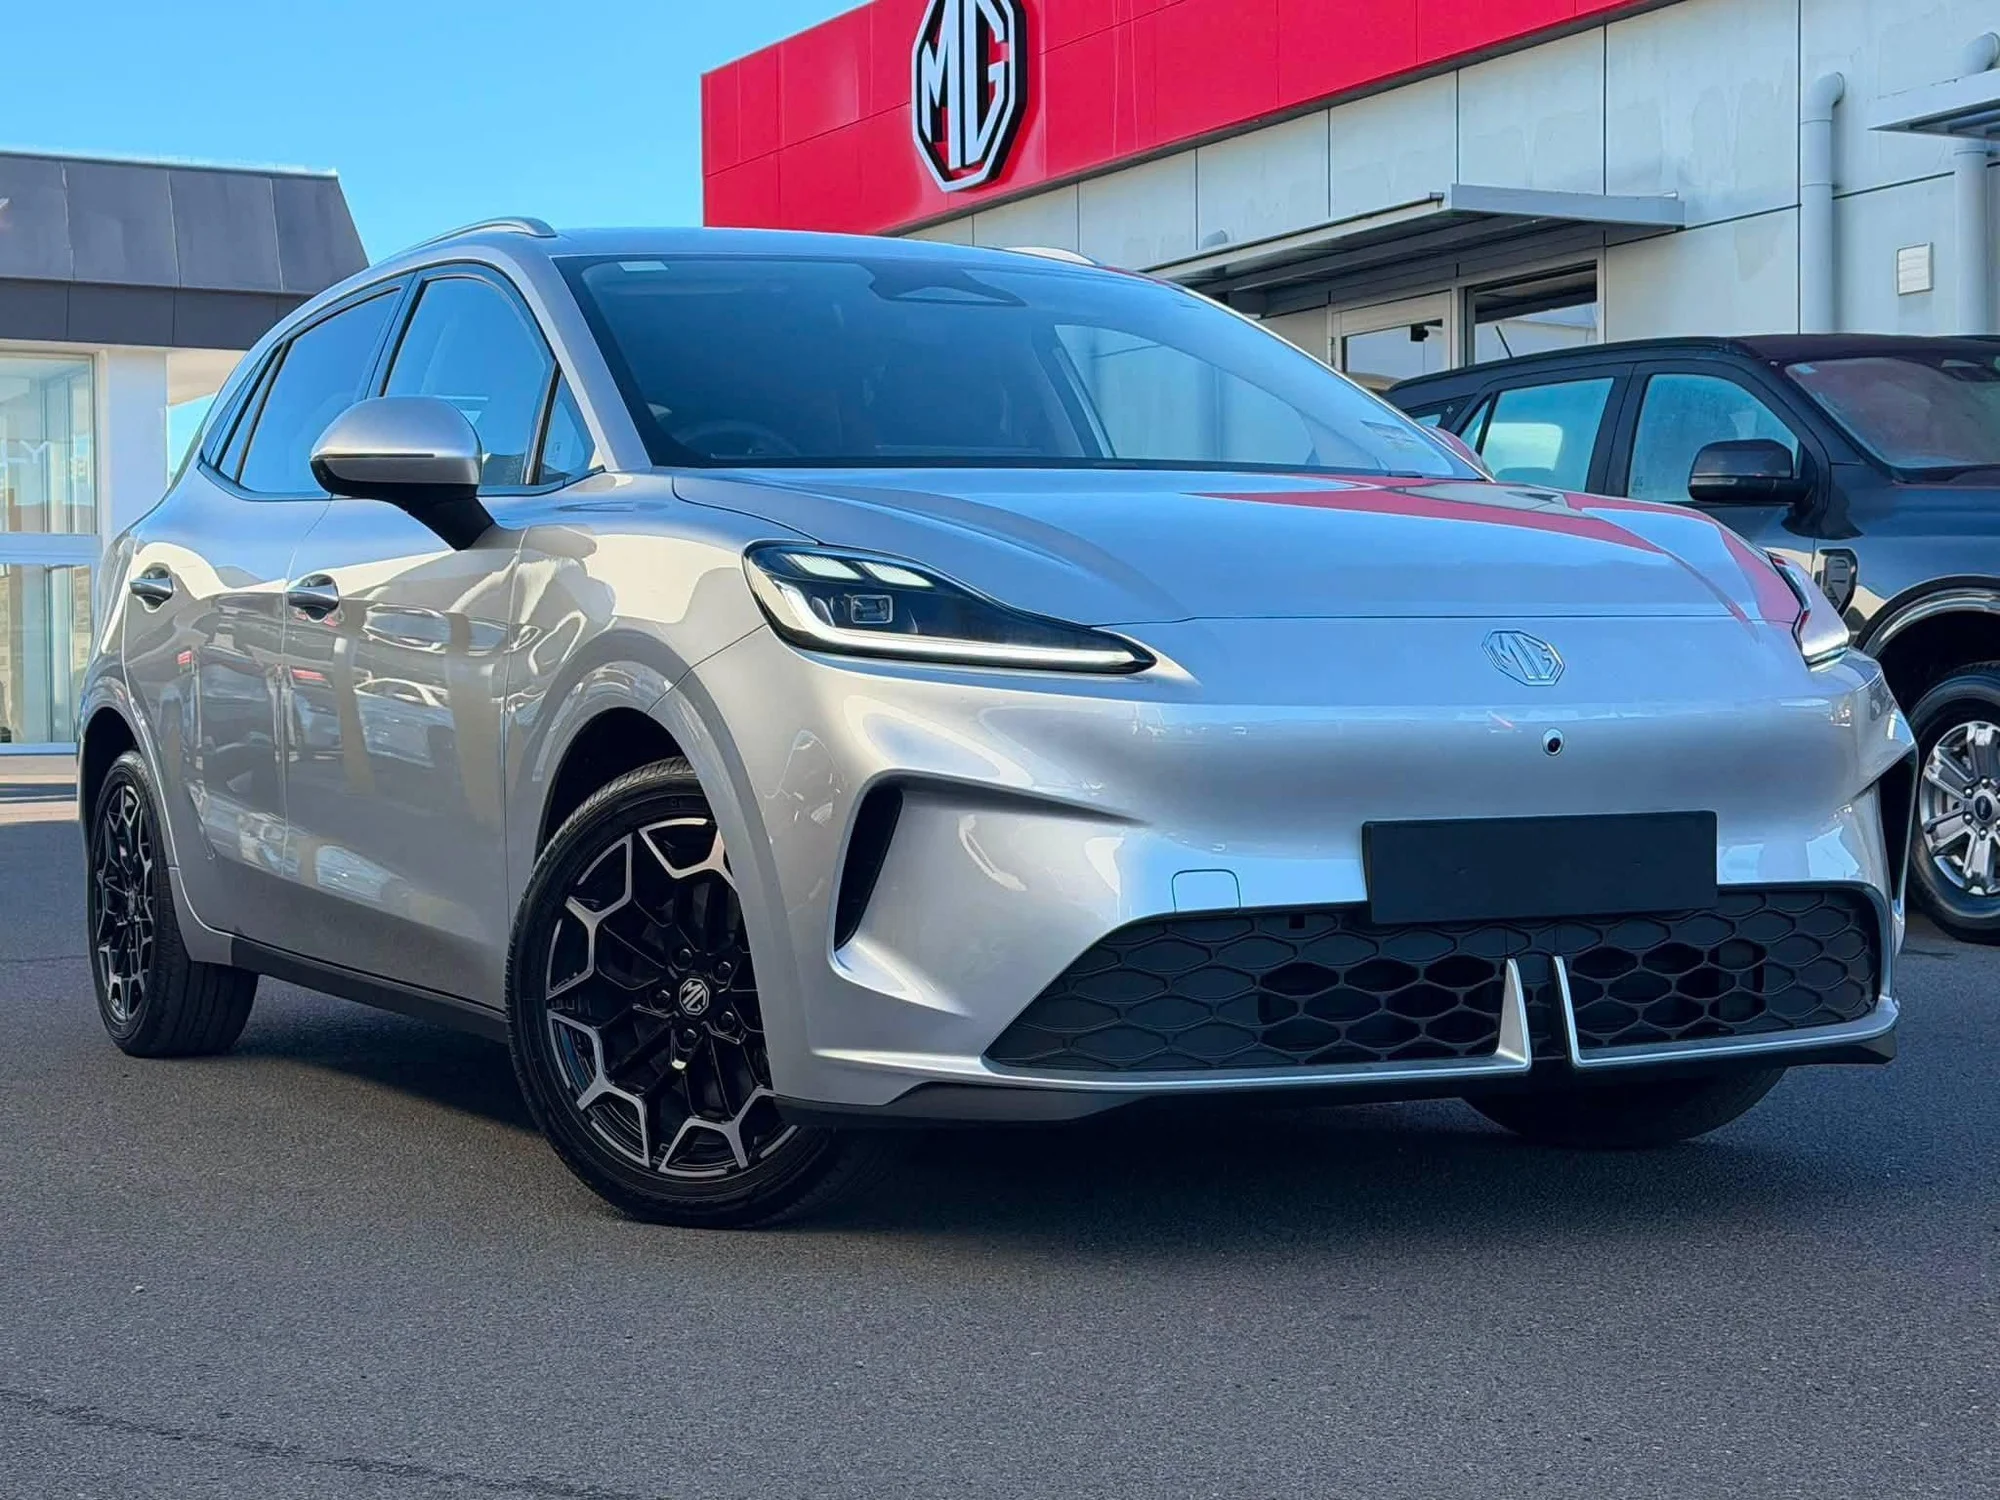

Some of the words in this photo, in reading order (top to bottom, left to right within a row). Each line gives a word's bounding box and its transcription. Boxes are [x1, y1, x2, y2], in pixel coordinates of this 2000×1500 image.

[919, 0, 1006, 172] MG
[1487, 631, 1560, 681] MG
[682, 981, 706, 1012] MG
